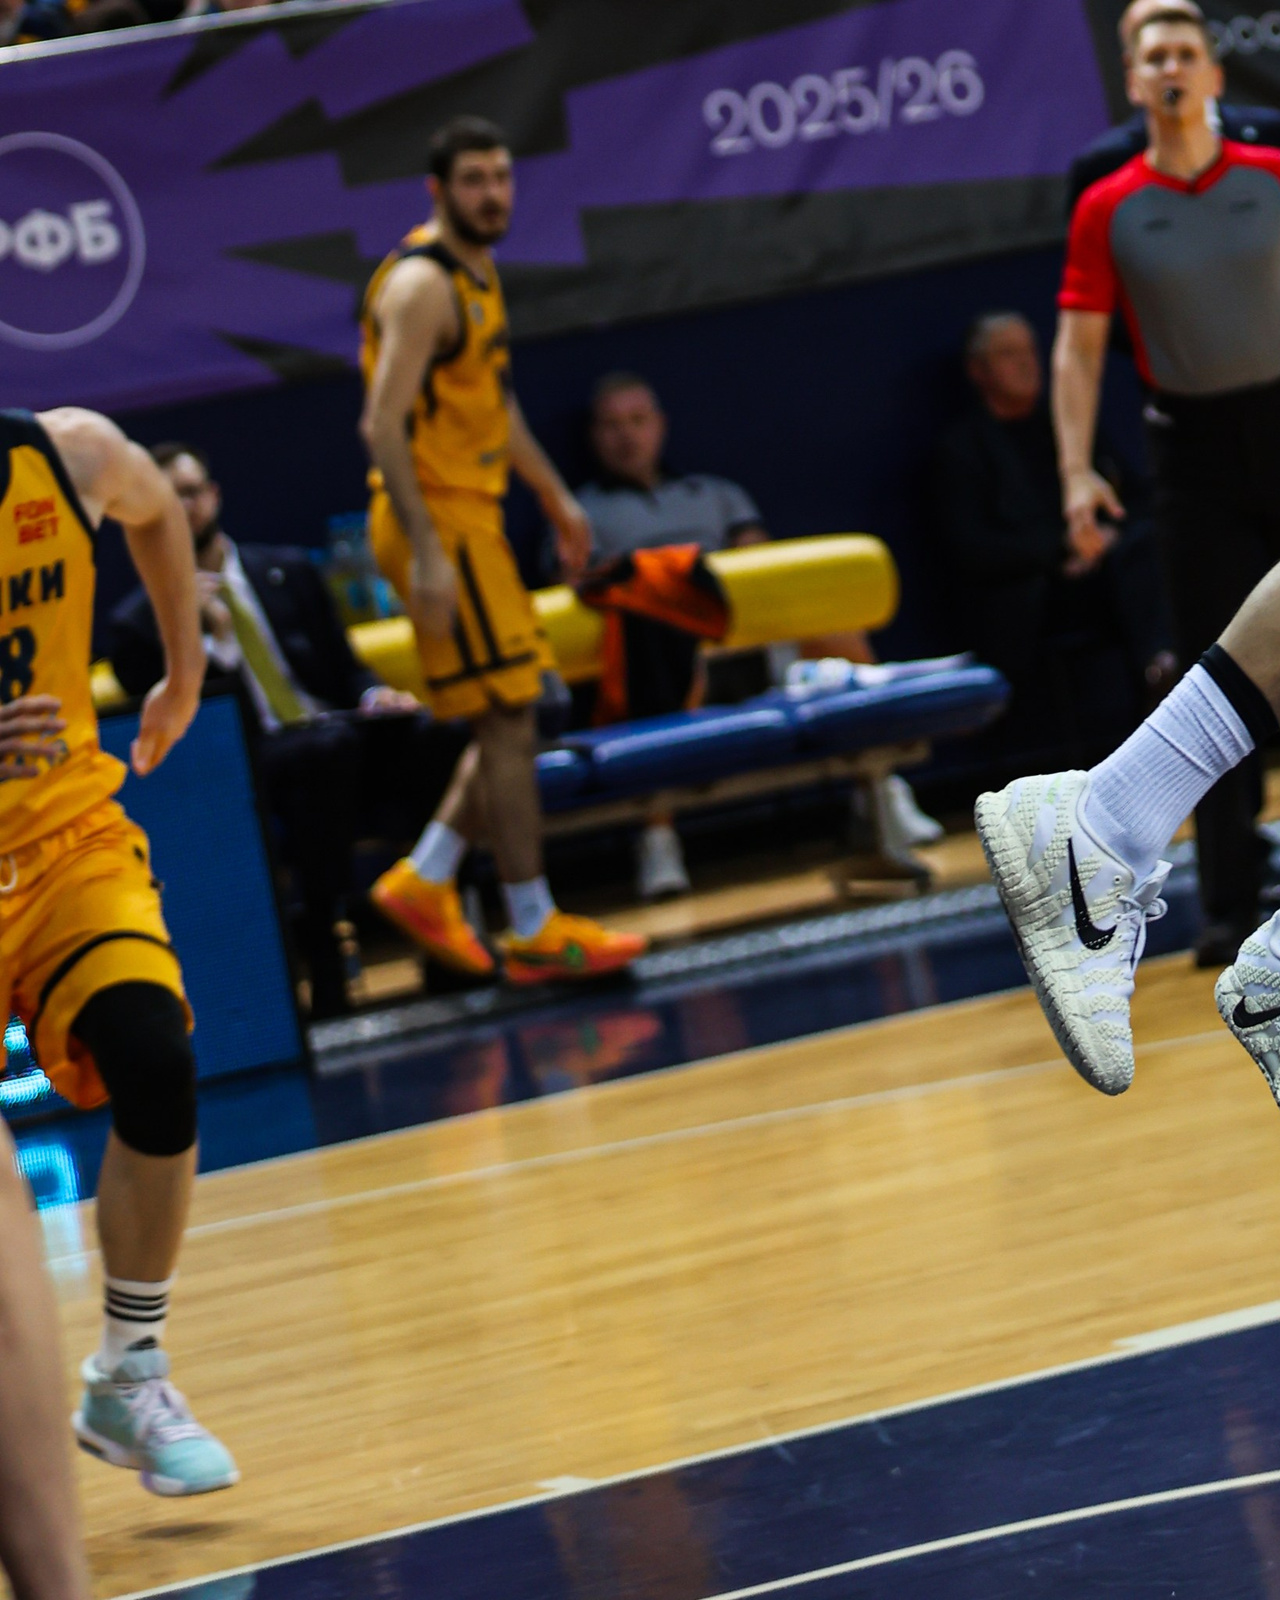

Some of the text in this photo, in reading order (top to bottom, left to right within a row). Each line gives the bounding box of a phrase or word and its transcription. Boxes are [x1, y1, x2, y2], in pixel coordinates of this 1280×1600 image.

[702, 49, 985, 157] 2025/26
[0, 199, 122, 273] ФБ
[0, 558, 65, 616] КИ
